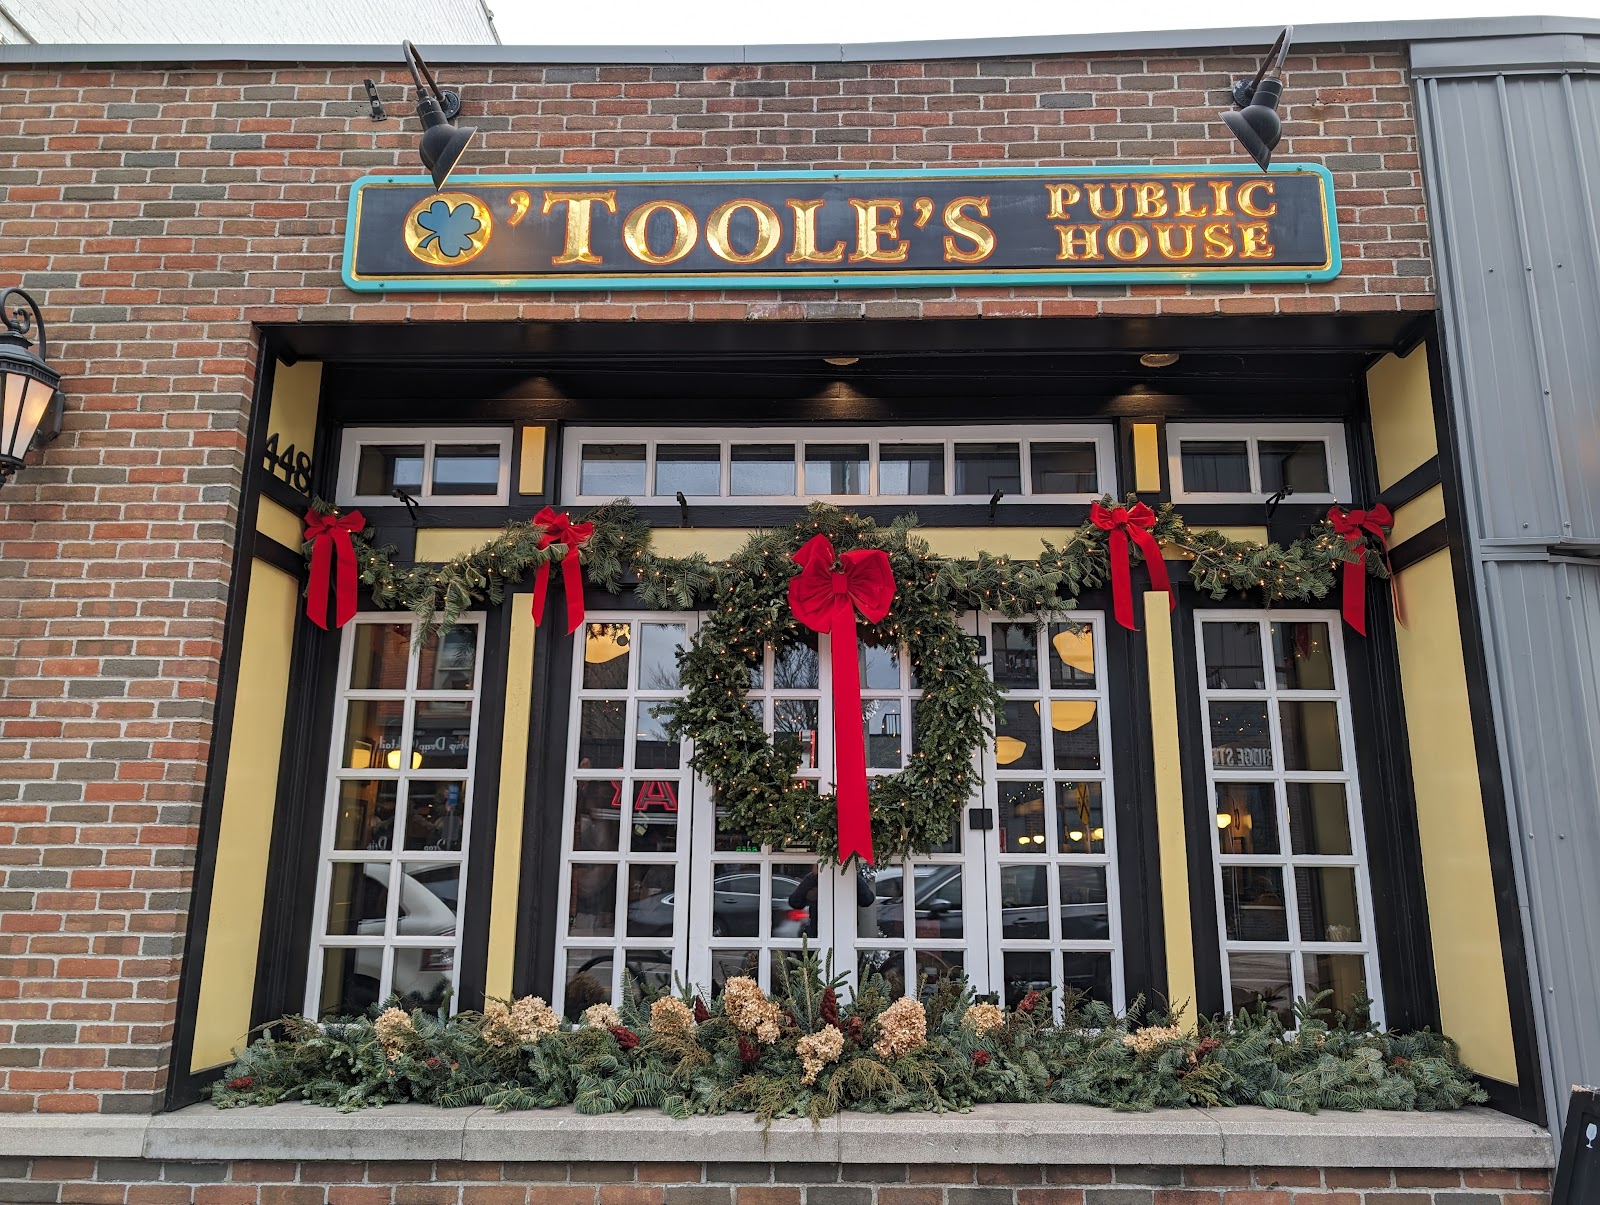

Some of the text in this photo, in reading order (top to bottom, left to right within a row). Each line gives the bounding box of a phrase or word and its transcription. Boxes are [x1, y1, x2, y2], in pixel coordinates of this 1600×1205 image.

[1045, 179, 1277, 219] PUBLIC
[1056, 221, 1275, 262] HOUSE
[262, 433, 311, 494] 448
